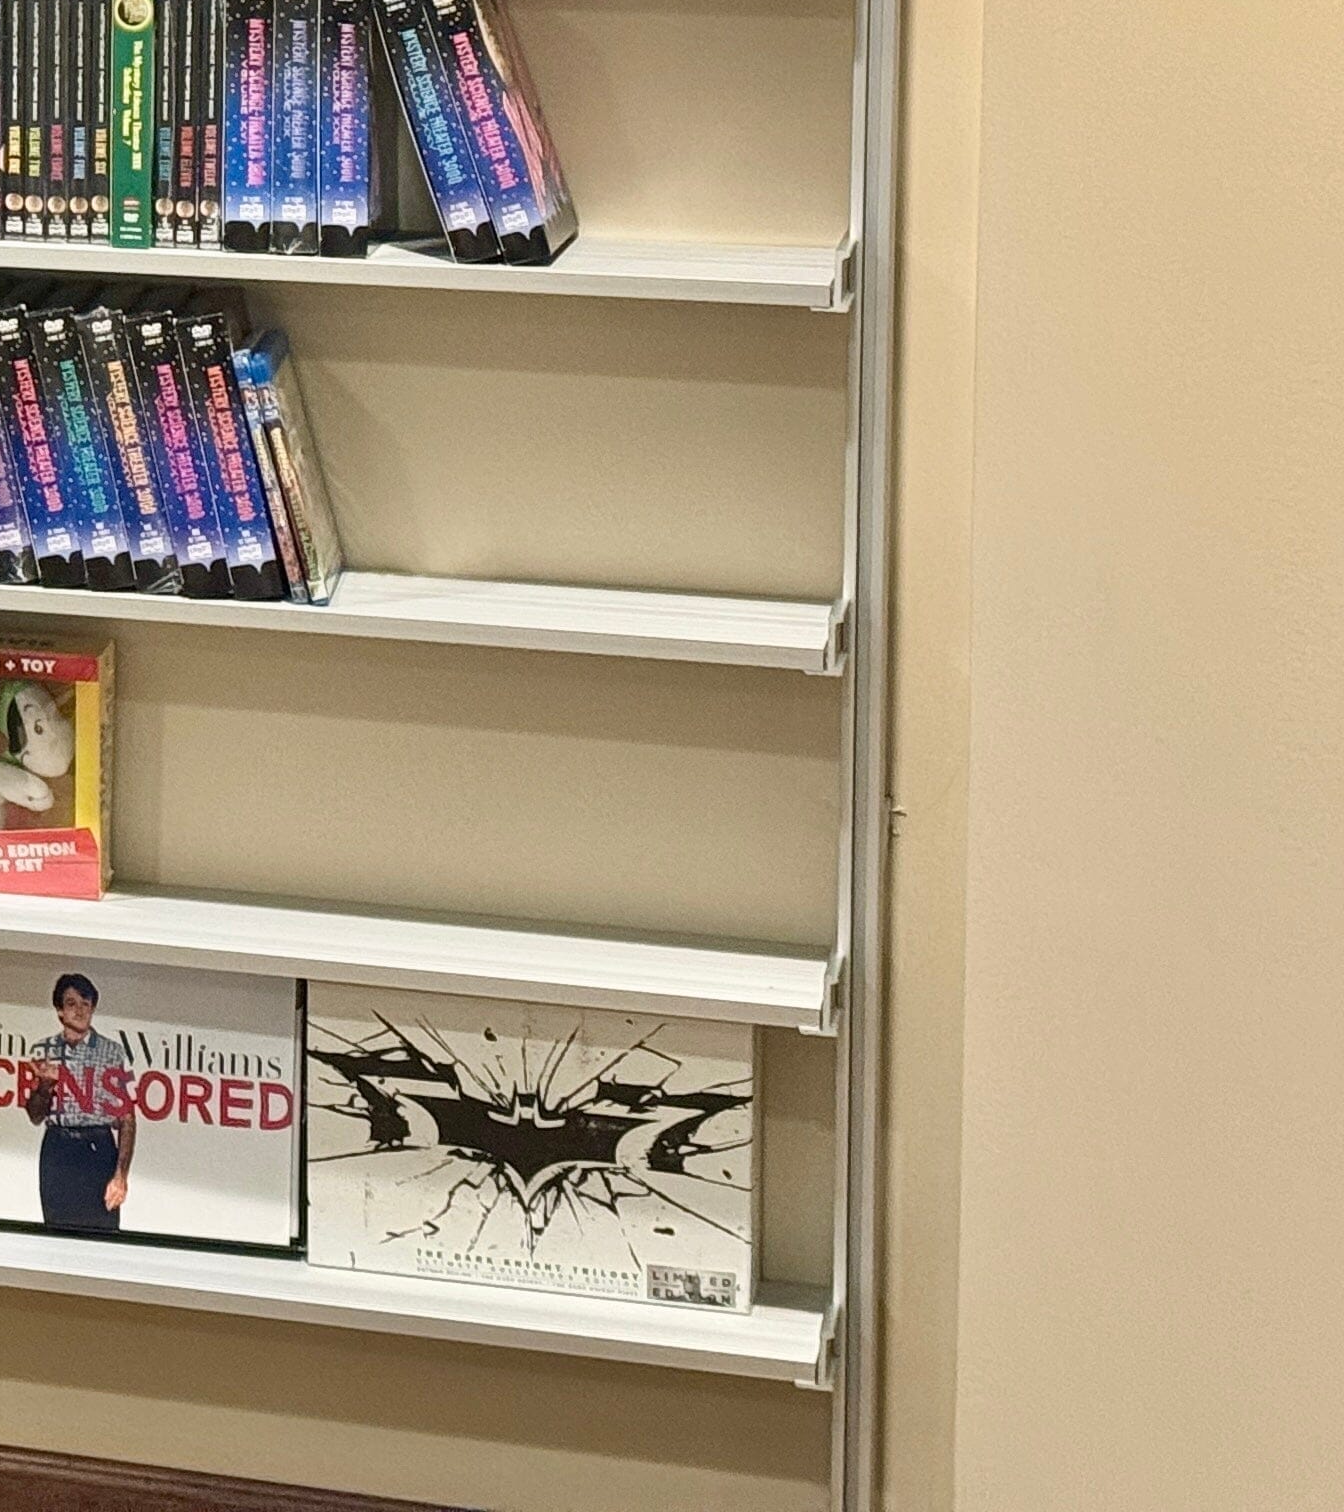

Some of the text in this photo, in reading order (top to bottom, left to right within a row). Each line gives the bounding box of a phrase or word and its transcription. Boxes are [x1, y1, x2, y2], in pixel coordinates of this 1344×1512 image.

[21, 658, 56, 675] TOY
[7, 842, 76, 858] EDITION
[15, 858, 44, 873] SET
[118, 1028, 284, 1079] Williams
[416, 1248, 640, 1280] THE DARK KNIGHT TRILOGY
